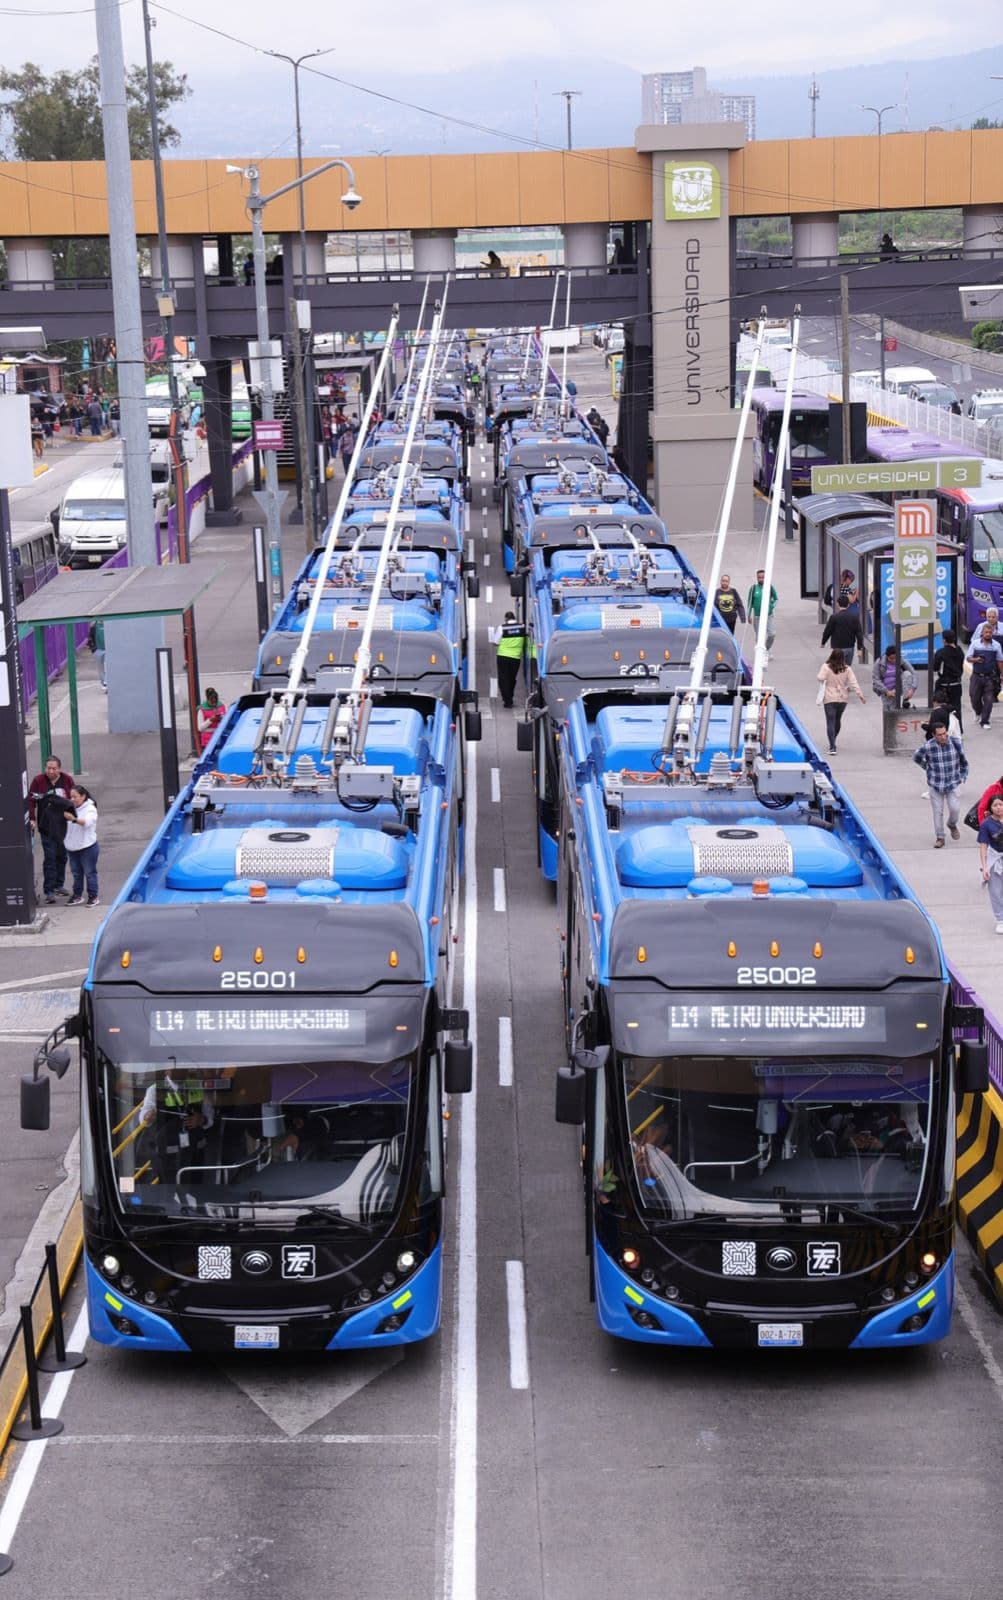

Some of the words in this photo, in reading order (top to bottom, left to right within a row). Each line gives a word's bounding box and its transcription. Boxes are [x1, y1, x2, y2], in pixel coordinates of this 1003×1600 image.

[685, 238, 701, 405] UNIVERSIDAD
[818, 471, 931, 486] UNIVERSIDAD
[953, 468, 968, 482] 3
[620, 664, 661, 676] 2500
[221, 971, 296, 988] 25001
[737, 967, 817, 985] 25002
[156, 1010, 184, 1031] L14
[196, 1010, 247, 1030] METRO
[250, 1009, 350, 1030] UNIVERSIDAD
[671, 1006, 698, 1028] L14
[711, 1006, 761, 1028] METRO
[765, 1006, 866, 1028] UNIVERSIDAD
